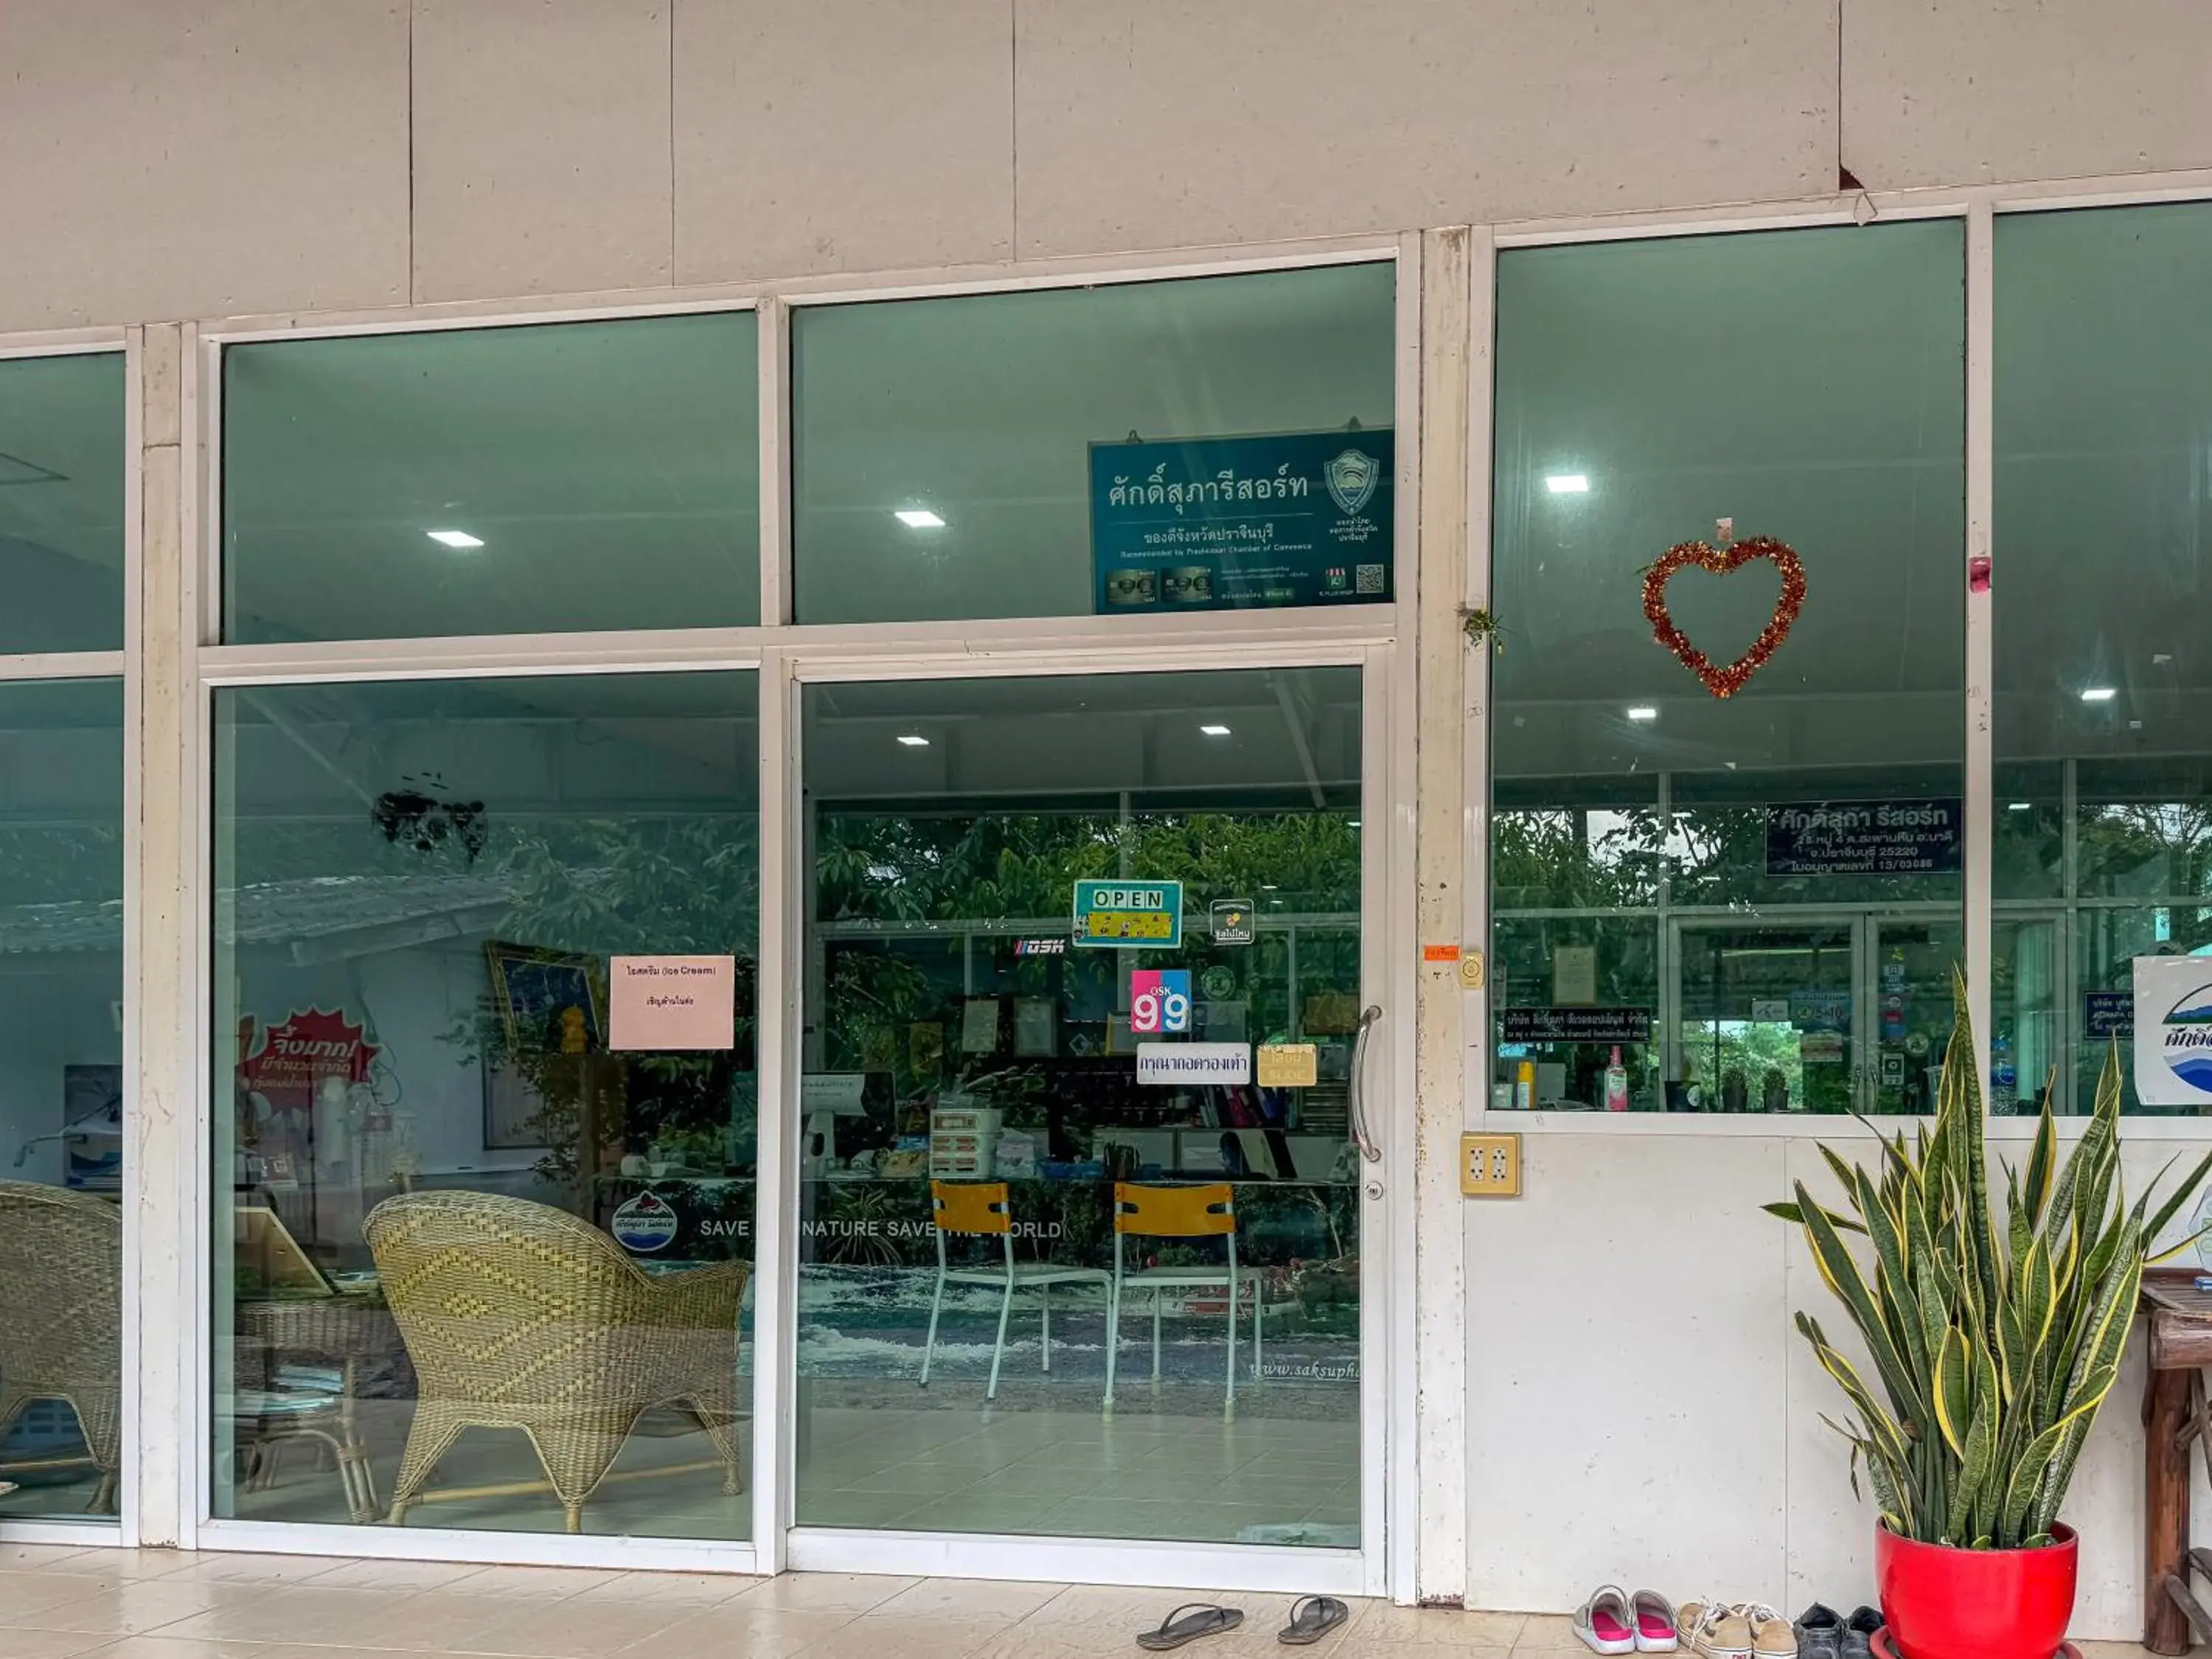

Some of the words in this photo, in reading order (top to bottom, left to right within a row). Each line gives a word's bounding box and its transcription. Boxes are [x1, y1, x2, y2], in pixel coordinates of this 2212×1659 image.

[1109, 462, 1308, 515] ศักดิ์สุภารีสอร์ท
[1144, 523, 1274, 544] ของดีจังหวัดปราจีนบุรี
[1093, 891, 1163, 908] OPEN
[662, 966, 679, 976] (Ice
[681, 966, 716, 976] Cream)
[1150, 985, 1172, 996] OSK
[1134, 994, 1189, 1031] 99
[1140, 1052, 1248, 1077] กรุณาถอดรองเท้า
[700, 1220, 750, 1237] SAVE
[801, 1220, 879, 1237] NATURE
[886, 1221, 936, 1237] SAVE
[992, 1222, 1062, 1238] ORLD
